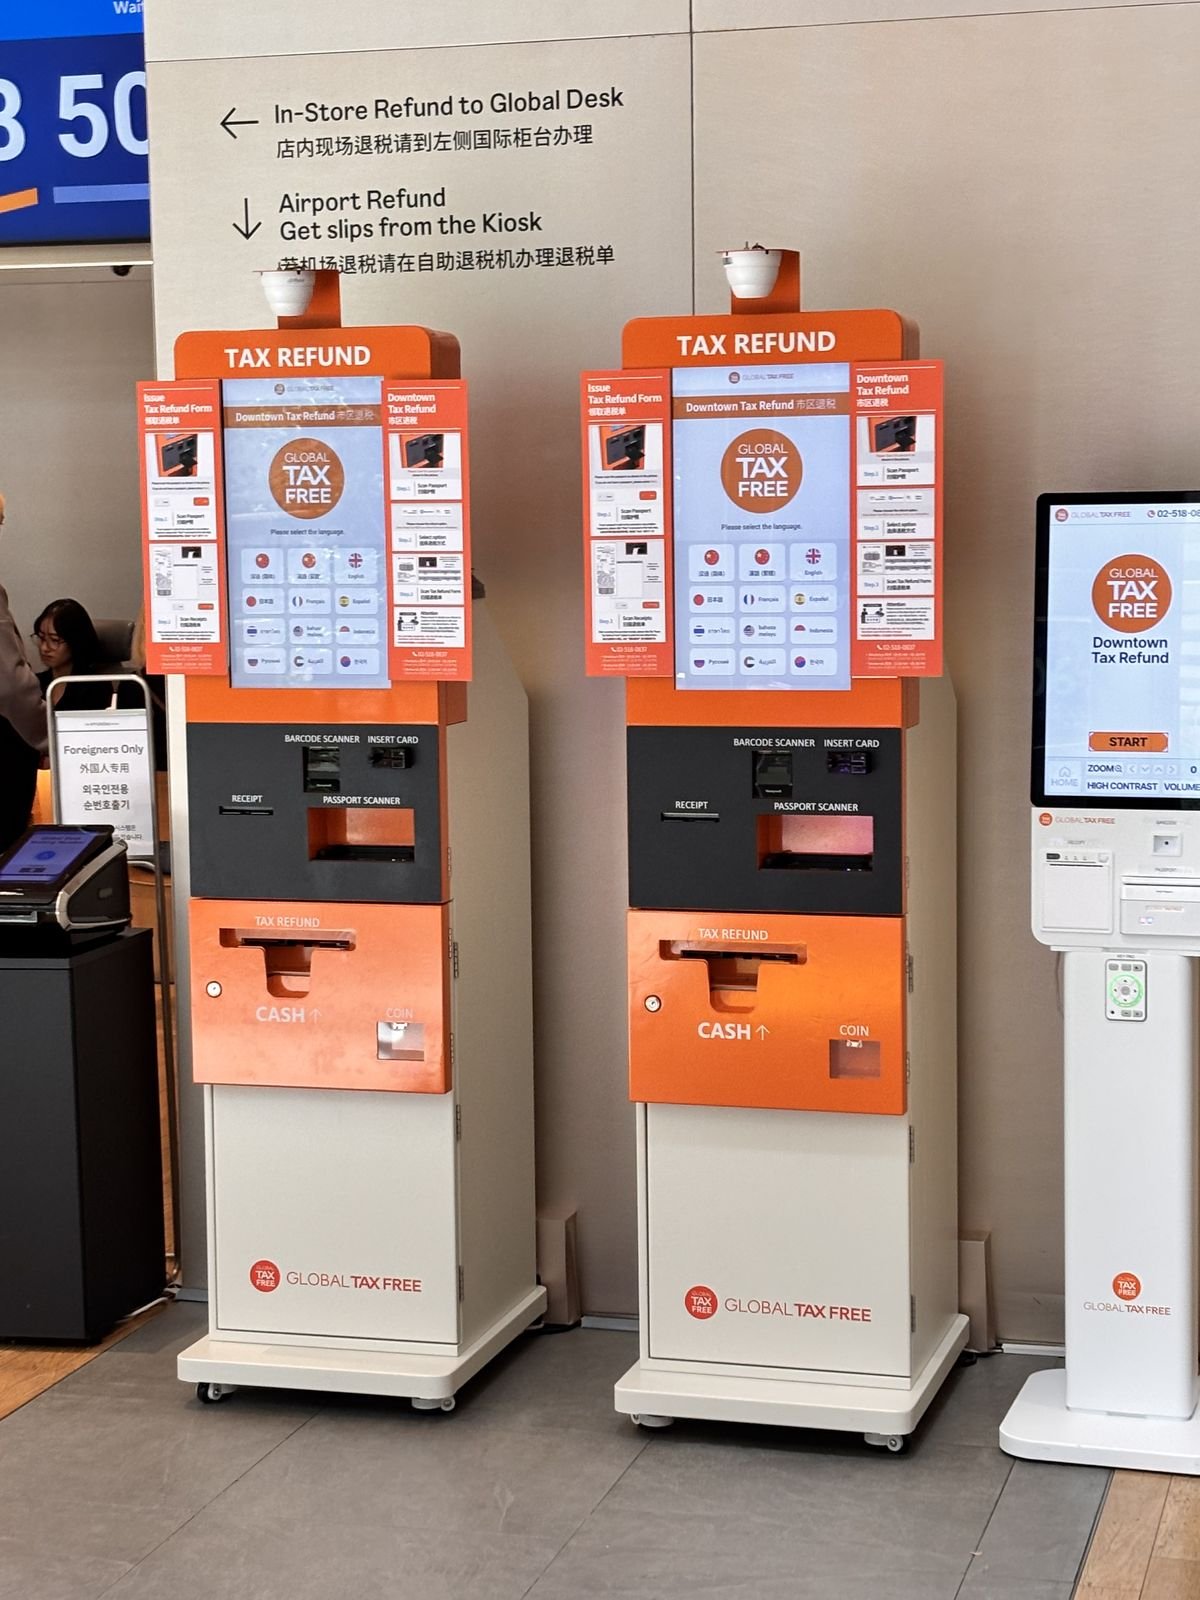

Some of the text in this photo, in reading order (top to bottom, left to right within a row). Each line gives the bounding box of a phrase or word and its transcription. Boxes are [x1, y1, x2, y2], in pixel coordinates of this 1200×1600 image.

[275, 87, 624, 124] In-Store Refund to Global Desk
[58, 71, 149, 158] 50
[276, 124, 592, 159] 店内现场退税请到左侧国际柜台办理
[279, 187, 447, 216] Airport Refund
[280, 211, 542, 243] Get slips from the Kiosk
[677, 330, 836, 356] TAX REFUND
[224, 345, 370, 368] TAX REFUND
[856, 374, 909, 384] Downtown
[588, 384, 611, 393] Issue
[857, 385, 909, 396] Tax Refund
[143, 393, 166, 402] Issue
[387, 393, 436, 402] Downtown
[588, 393, 662, 405] Tax Refund Form
[144, 403, 213, 414] Tax Refund Form
[388, 404, 437, 414] Tax Refund
[686, 402, 738, 413] Downtown
[740, 401, 757, 412] Tax
[759, 400, 794, 411] Refund
[235, 411, 284, 422] Downtown
[285, 411, 302, 421] Tax
[303, 410, 336, 421] Refund
[738, 443, 789, 455] GLOBAL
[284, 452, 330, 463] GLOBAL
[735, 456, 789, 479] TAX
[282, 465, 331, 486] TAX
[738, 480, 789, 497] FREE
[285, 488, 332, 504] FREE
[270, 528, 289, 536] Please
[290, 528, 307, 536] select
[721, 523, 742, 531] Please
[742, 523, 761, 531] select
[1109, 567, 1159, 579] GLOBAL
[1106, 580, 1159, 601] TAX
[1108, 602, 1158, 618] FREE
[1092, 636, 1168, 649] Downtown
[1091, 652, 1169, 664] Tax Refund
[285, 735, 360, 744] BARCODE SCANNER
[367, 735, 419, 744] INSERT CARD
[734, 738, 815, 747] BARCODE SCANNER
[824, 739, 880, 748] INSERT CARD
[1108, 736, 1148, 747] START
[63, 744, 144, 756] Foreigners Only
[80, 762, 130, 774] 外国人专用
[1087, 764, 1115, 773] ZOOM
[1051, 779, 1078, 787] HOME
[1087, 782, 1159, 791] HIGH CONTRAST
[1163, 783, 1200, 792] VOLUME
[82, 784, 129, 795] 외국인전용
[231, 794, 263, 803] RECEIPT
[322, 795, 401, 805] PASSPORT SCANNER
[675, 801, 708, 810] RECEIPT
[773, 802, 859, 812] PASSPORT SCANNER
[256, 916, 320, 928] TAX REFUND
[698, 928, 769, 941] TAX REFUND
[256, 1006, 306, 1023] CASH
[386, 1008, 413, 1019] COIN
[697, 1022, 751, 1040] CASH
[839, 1024, 869, 1037] COIN
[255, 1270, 275, 1280] TAX
[256, 1279, 275, 1288] FREE
[286, 1271, 422, 1293] GLOBAL TAX FREE
[1117, 1280, 1137, 1290] TAX
[1118, 1289, 1137, 1297] FREE
[690, 1296, 712, 1306] TAX
[691, 1305, 712, 1314] FREE
[725, 1298, 872, 1322] GLOBAL TAX FREE
[1083, 1301, 1172, 1316] GLOBAL TAX FREE
